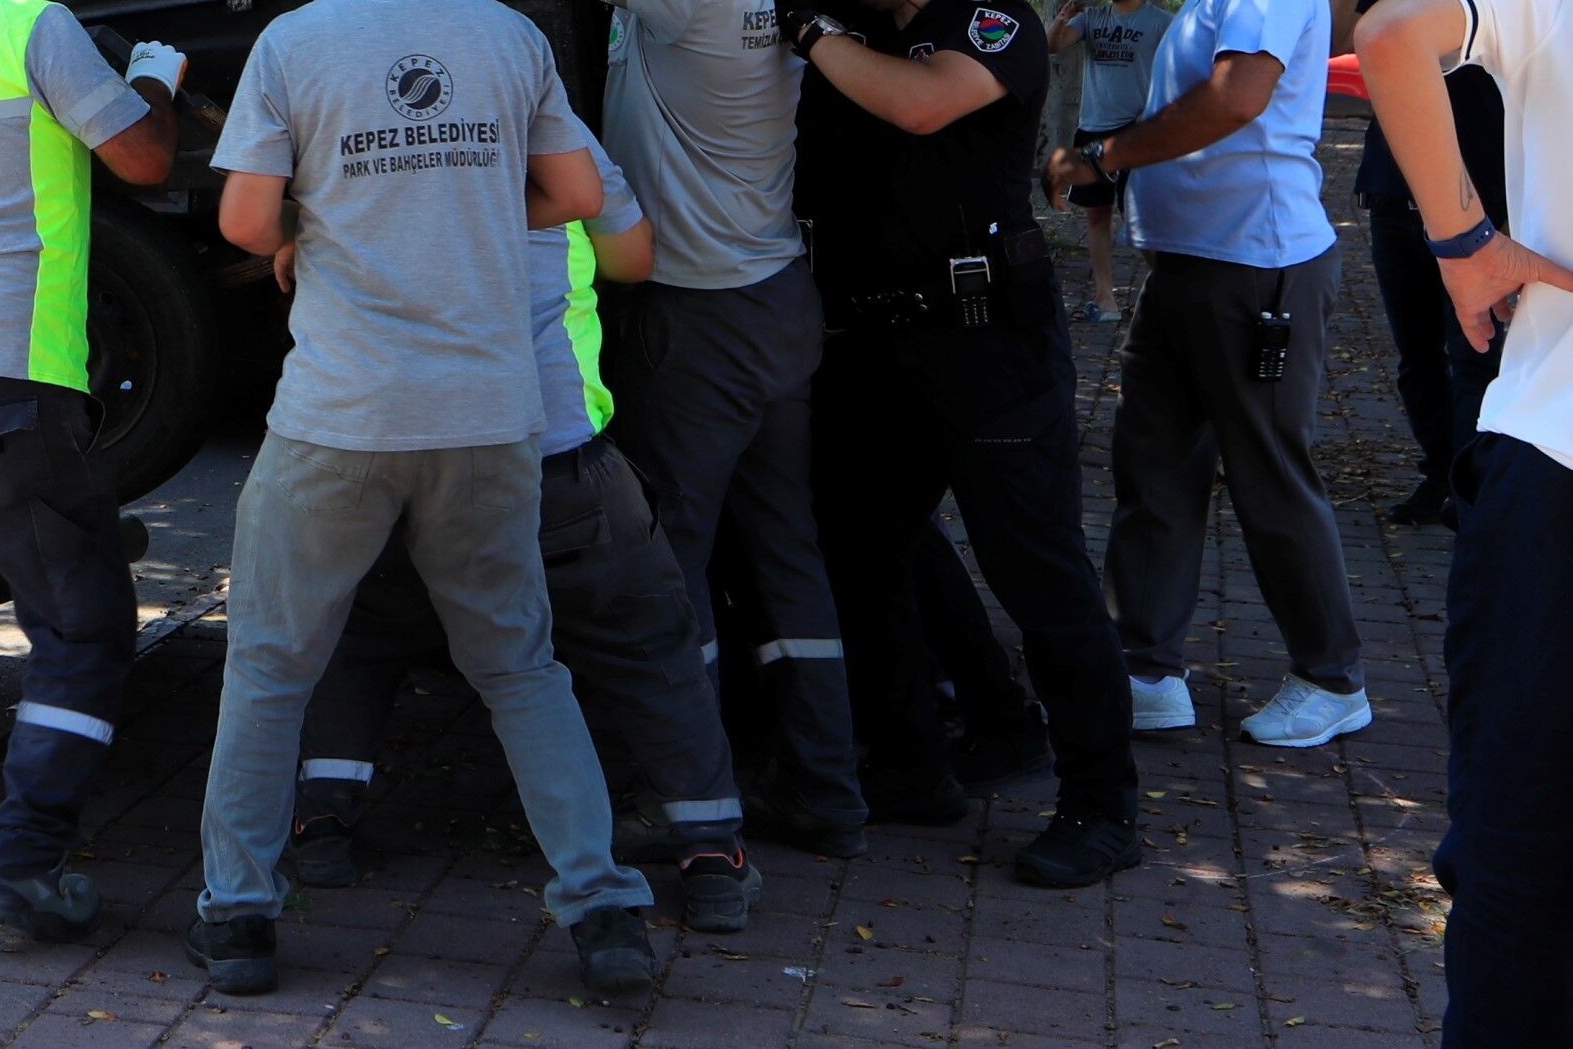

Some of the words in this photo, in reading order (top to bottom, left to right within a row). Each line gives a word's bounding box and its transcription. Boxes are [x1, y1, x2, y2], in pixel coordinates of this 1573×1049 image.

[742, 9, 779, 31] KEPE
[985, 11, 1011, 26] KEPEZ
[1093, 25, 1144, 44] BLADE
[389, 58, 445, 82] KEPEZ
[341, 128, 400, 156] KEPEZ
[404, 118, 500, 147] BELEDİYESİ
[343, 161, 371, 179] PARK
[374, 158, 387, 174] VE
[390, 152, 442, 176] BAHÇELER
[444, 147, 500, 168] MÜDÜRLÜĞ
